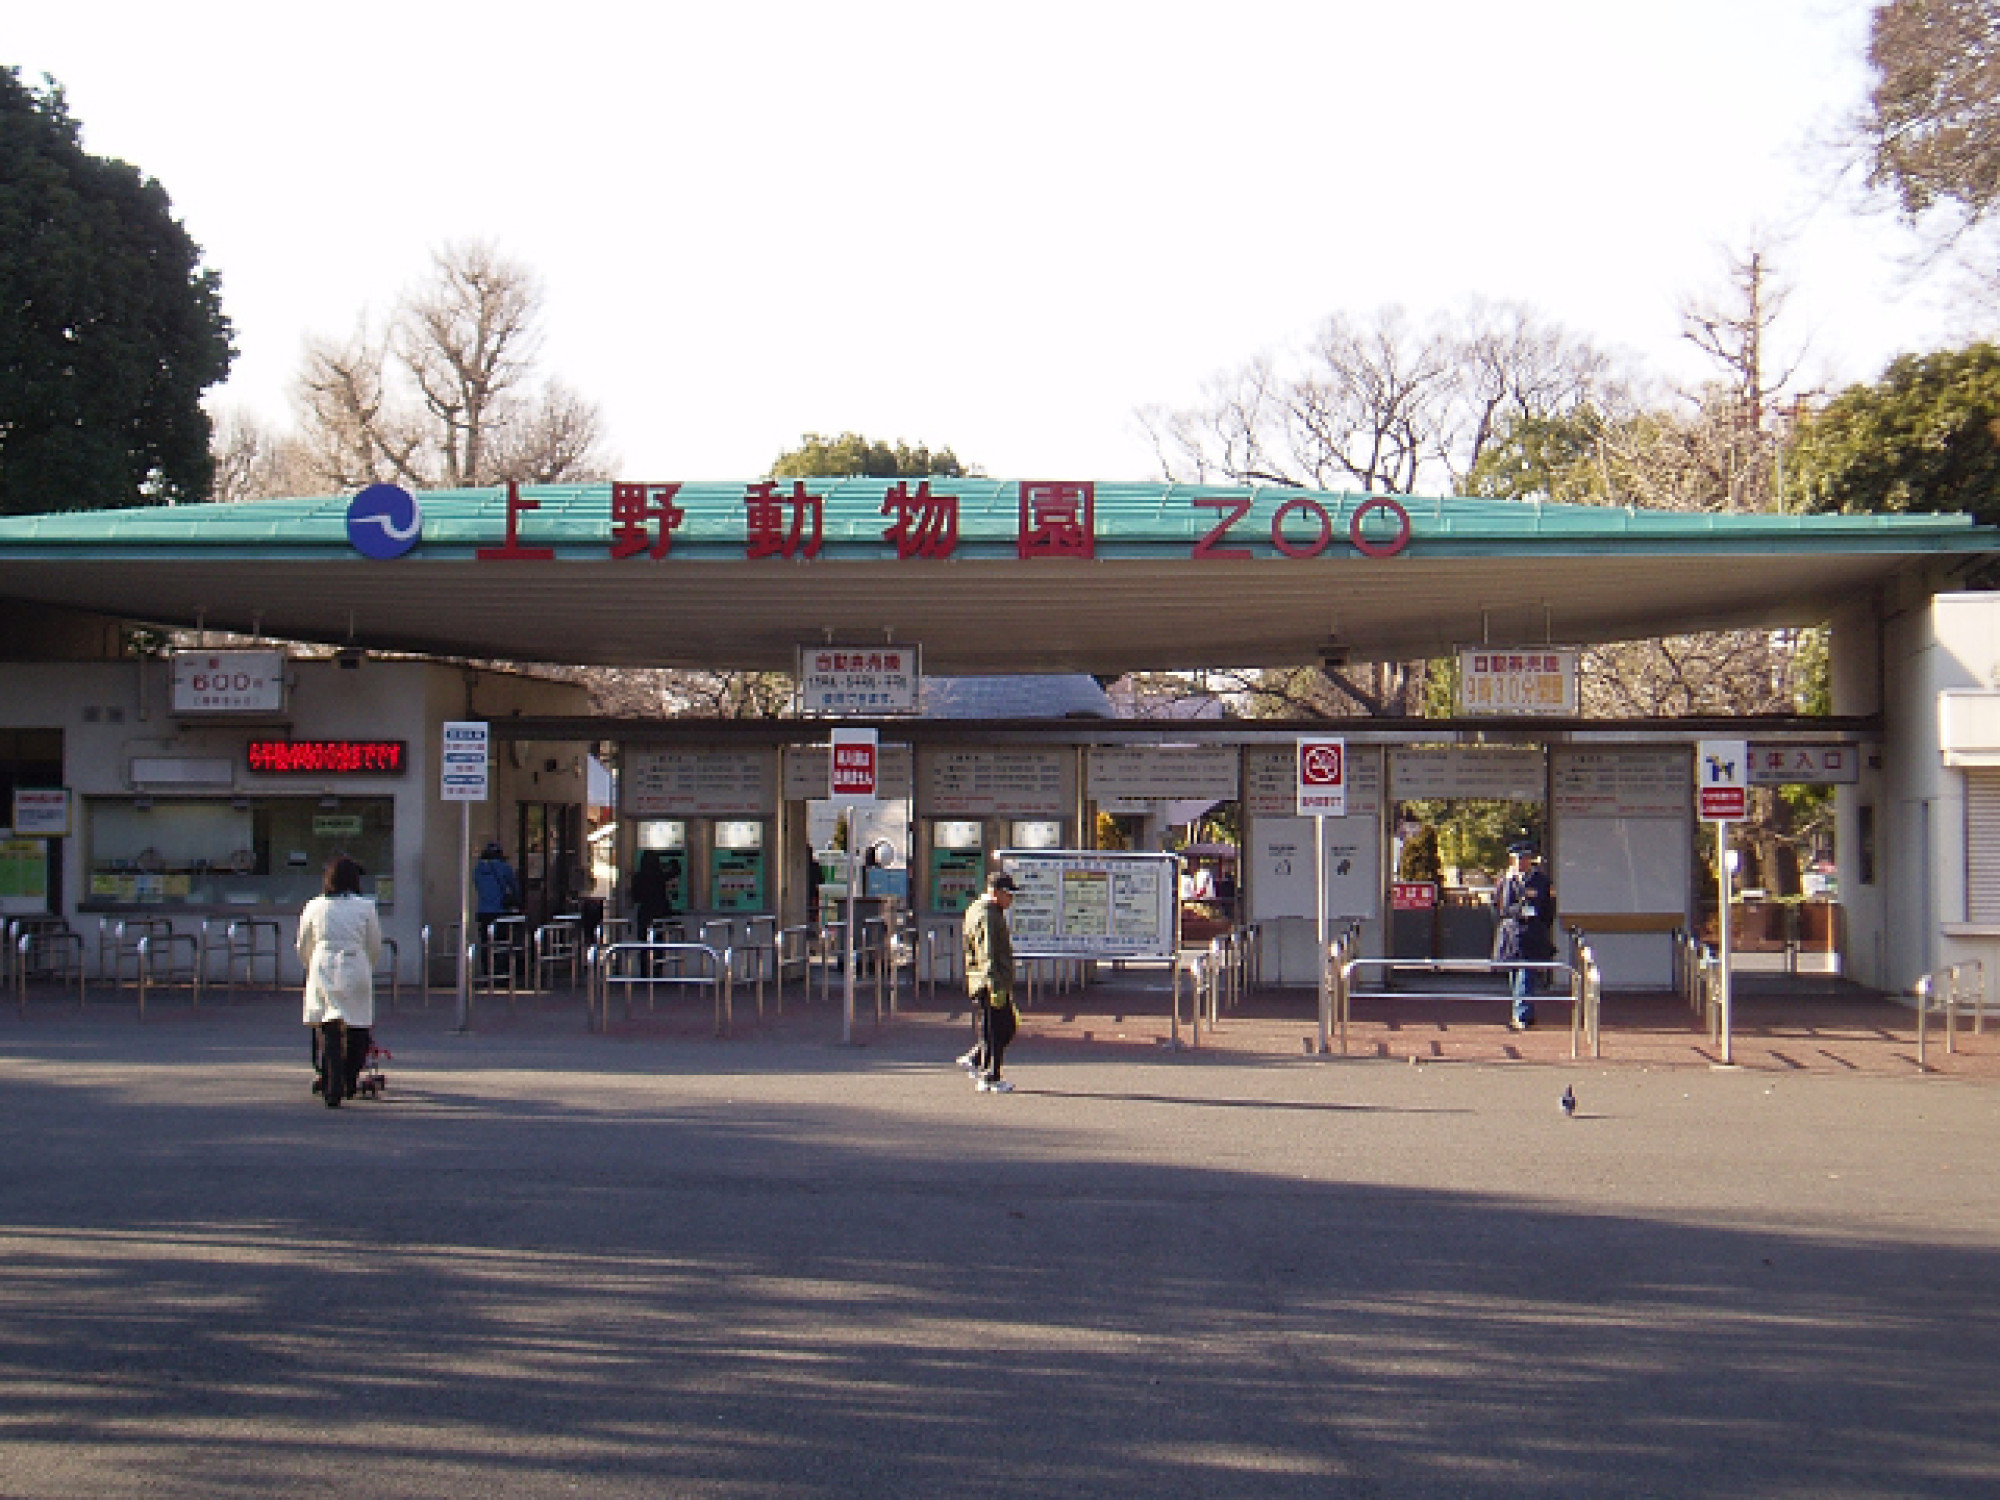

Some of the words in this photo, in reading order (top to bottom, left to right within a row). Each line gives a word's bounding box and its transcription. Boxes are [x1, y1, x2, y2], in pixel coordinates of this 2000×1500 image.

[476, 481, 1095, 561] 上野動物園
[1194, 497, 1411, 560] ZOO
